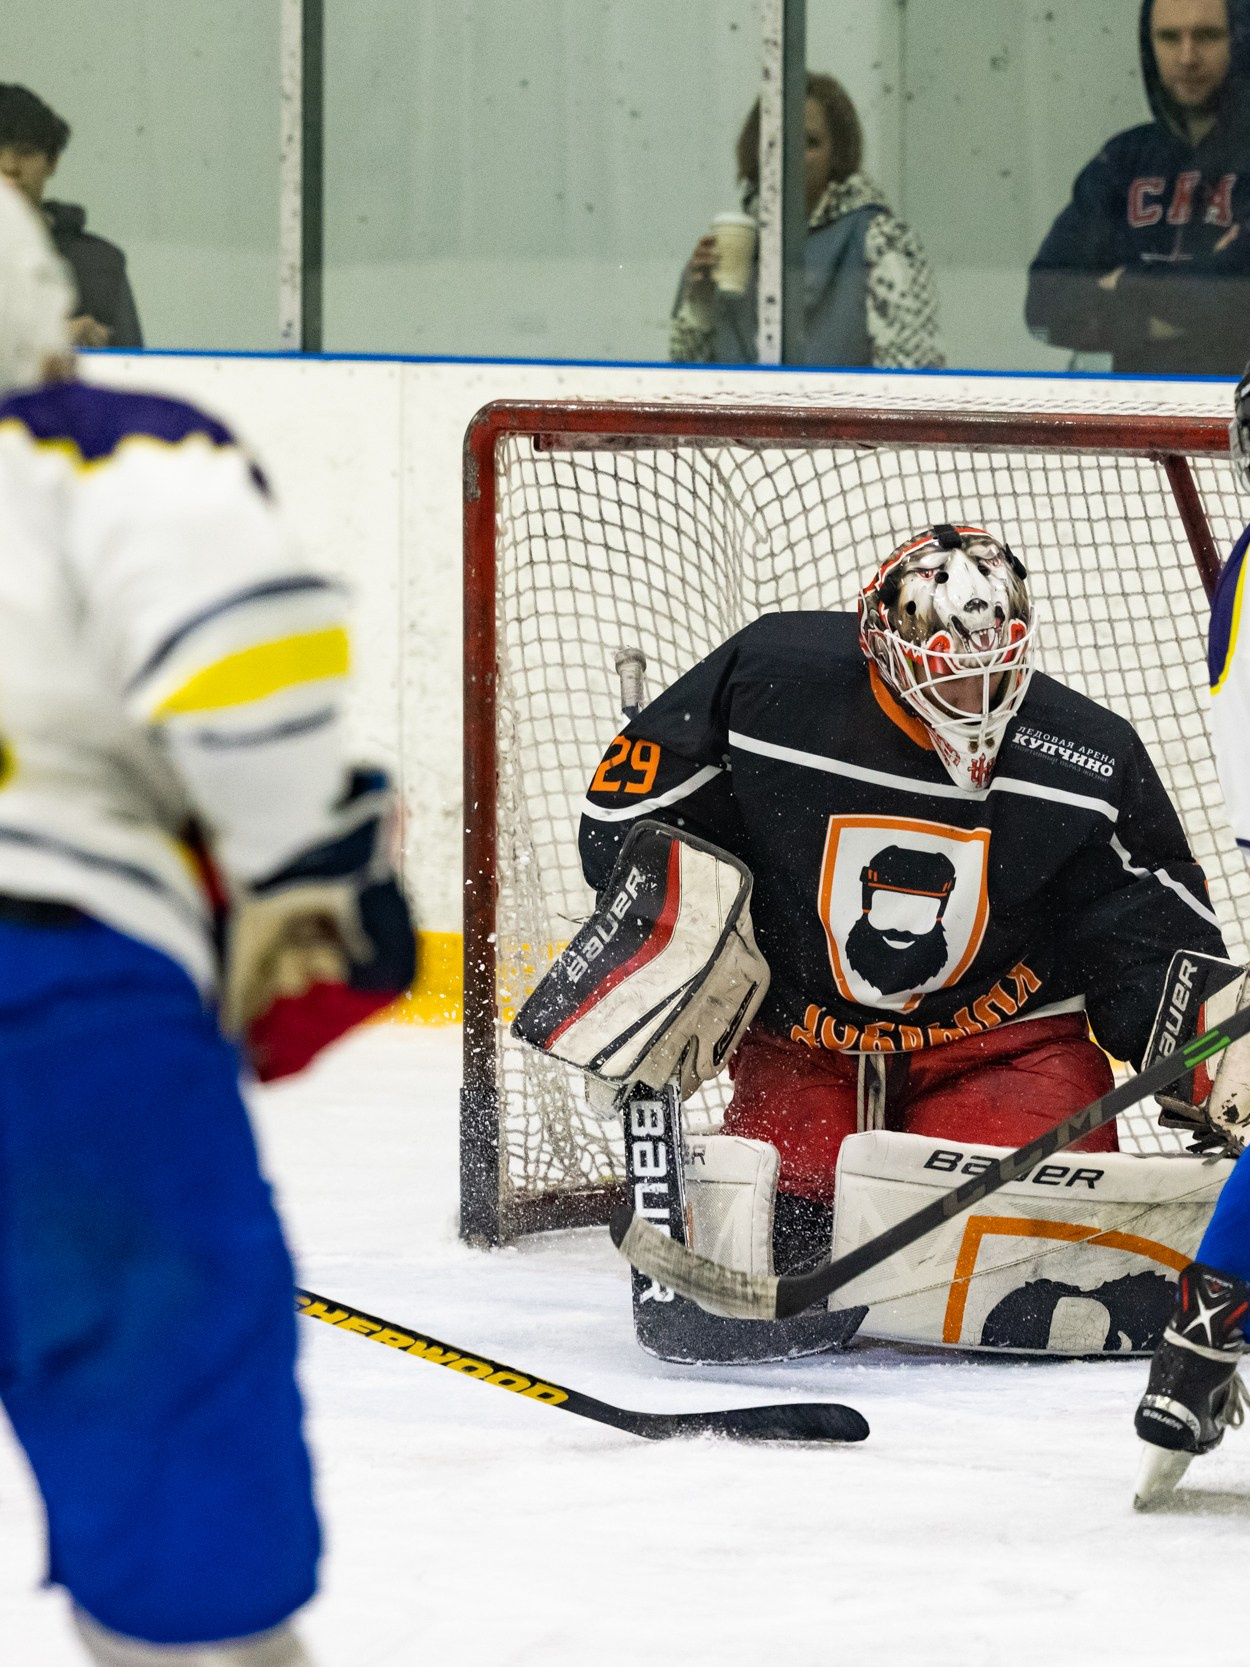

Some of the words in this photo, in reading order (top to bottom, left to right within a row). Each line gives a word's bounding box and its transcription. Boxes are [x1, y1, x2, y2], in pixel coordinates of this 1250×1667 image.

[590, 735, 661, 794] 29
[1011, 732, 1114, 777] КУПЧИНО
[1016, 725, 1075, 750] ЛЕДОВАЯ
[1078, 745, 1116, 766] АРЕНА
[567, 866, 647, 984] BAUER
[1155, 958, 1198, 1066] AUER
[923, 1149, 1105, 1189] BAER
[630, 1100, 676, 1304] BAUR
